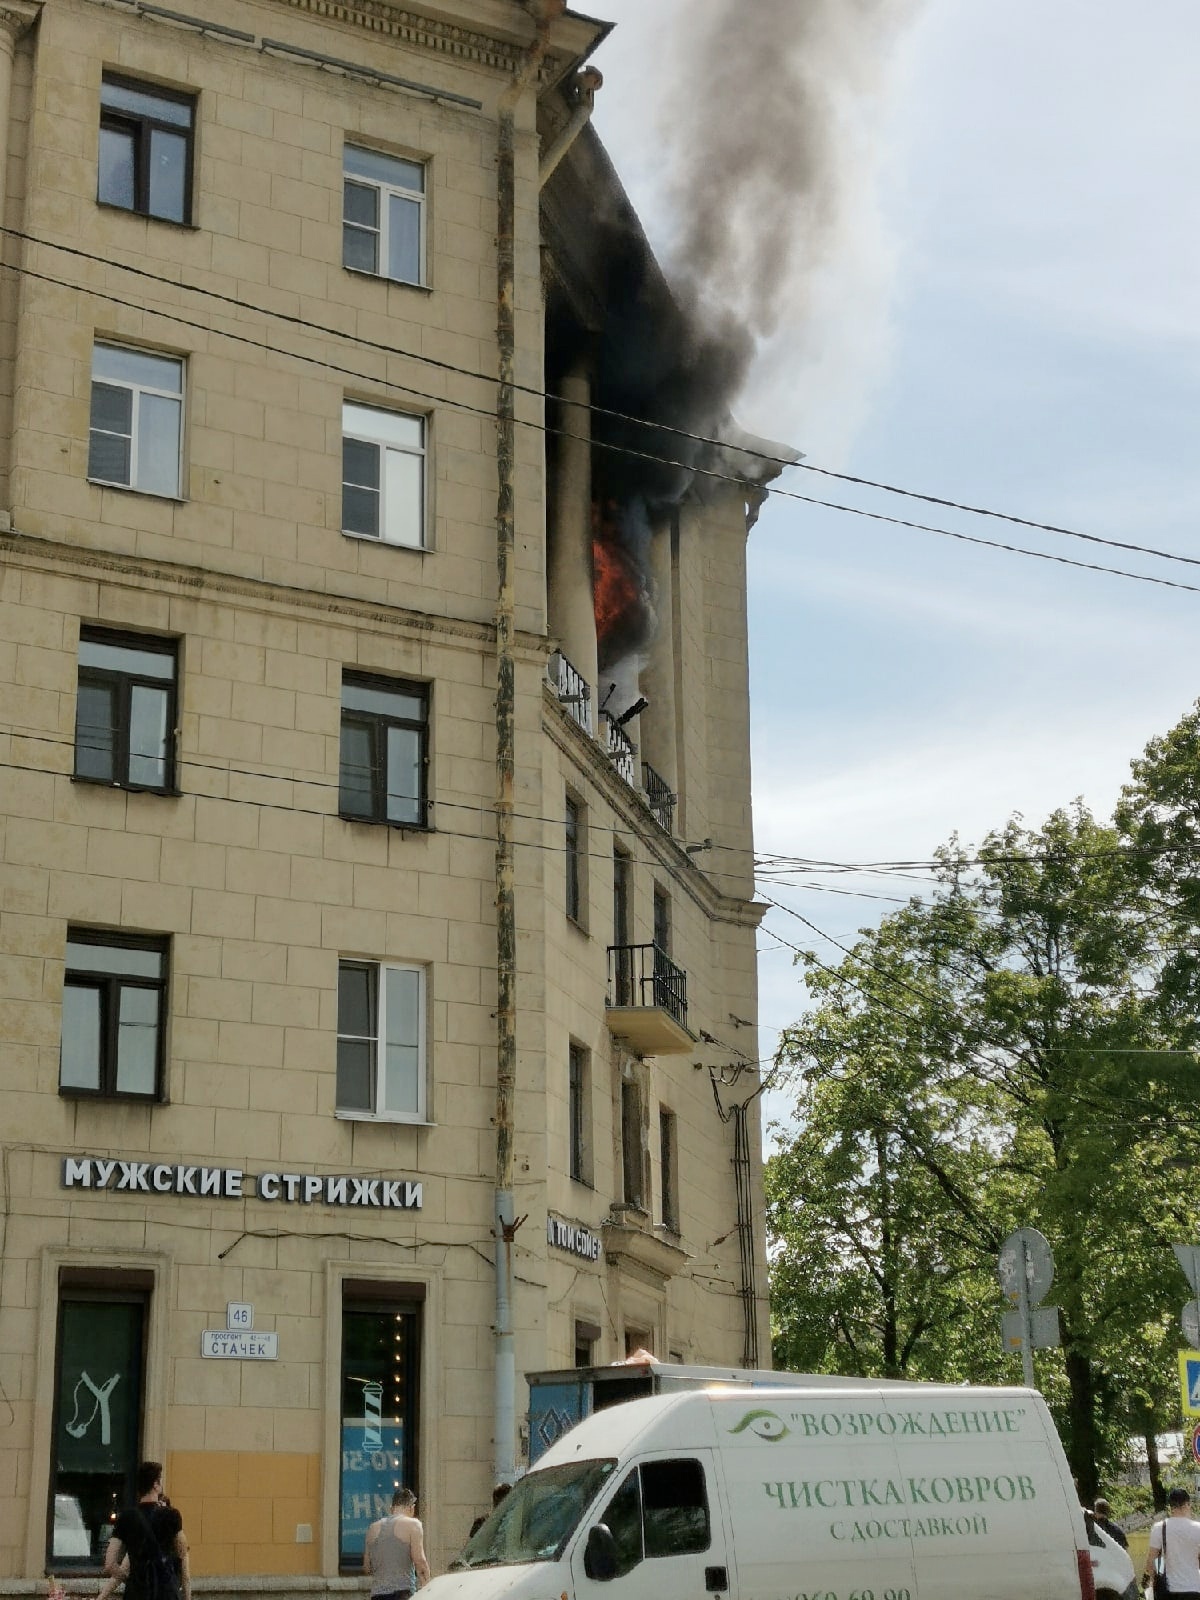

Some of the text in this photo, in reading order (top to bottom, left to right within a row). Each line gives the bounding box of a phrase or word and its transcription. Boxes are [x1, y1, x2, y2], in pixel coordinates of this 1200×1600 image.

[64, 1158, 423, 1208] МУЖСКИЕ СТРИЖКИ
[233, 1309, 248, 1323] 46
[211, 1342, 265, 1355] СТАЧЕК
[762, 1475, 1037, 1509] ЧИСТКА КОВРОВ
[830, 1513, 988, 1543] С ДОСТАВКОЙ
